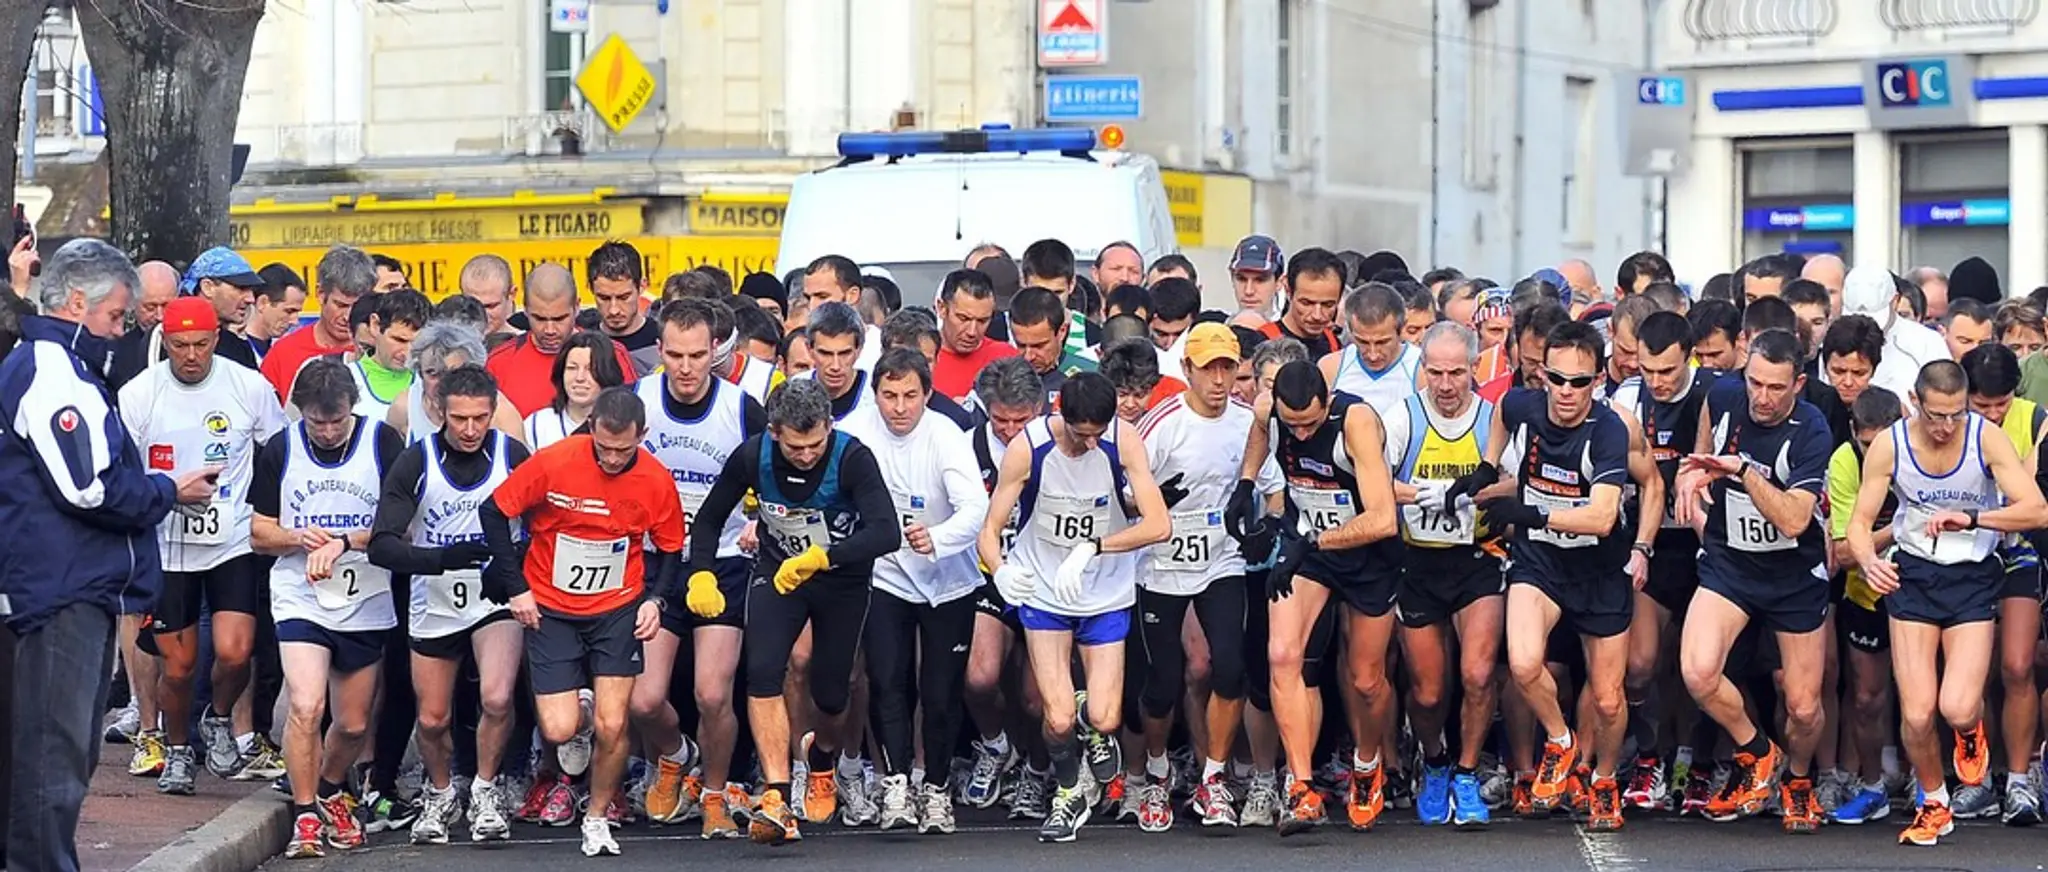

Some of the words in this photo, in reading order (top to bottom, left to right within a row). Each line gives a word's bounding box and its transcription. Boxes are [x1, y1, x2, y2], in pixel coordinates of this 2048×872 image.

[1640, 79, 1679, 102] CIC
[1882, 65, 1945, 102] CIC
[611, 77, 651, 126] PRESSE
[282, 225, 343, 246] LIBRAIRIE
[353, 221, 420, 242] PAPETERIE
[430, 219, 482, 241] PRESSE
[519, 213, 540, 235] LE
[545, 211, 611, 234] FIGARO
[660, 432, 700, 450] CHATEAU
[701, 441, 715, 457] DU
[1418, 463, 1429, 479] AS
[307, 480, 346, 496] CHATEAU
[347, 482, 359, 497] DU
[1916, 489, 1961, 502] CHATEAU
[183, 506, 219, 535] 153
[442, 499, 480, 517] CHATEA
[1054, 513, 1094, 540] 169
[1738, 516, 1778, 544] 150
[1171, 534, 1210, 562] 251
[343, 568, 359, 597] 2
[568, 565, 611, 591] 277
[453, 582, 468, 609] 9
